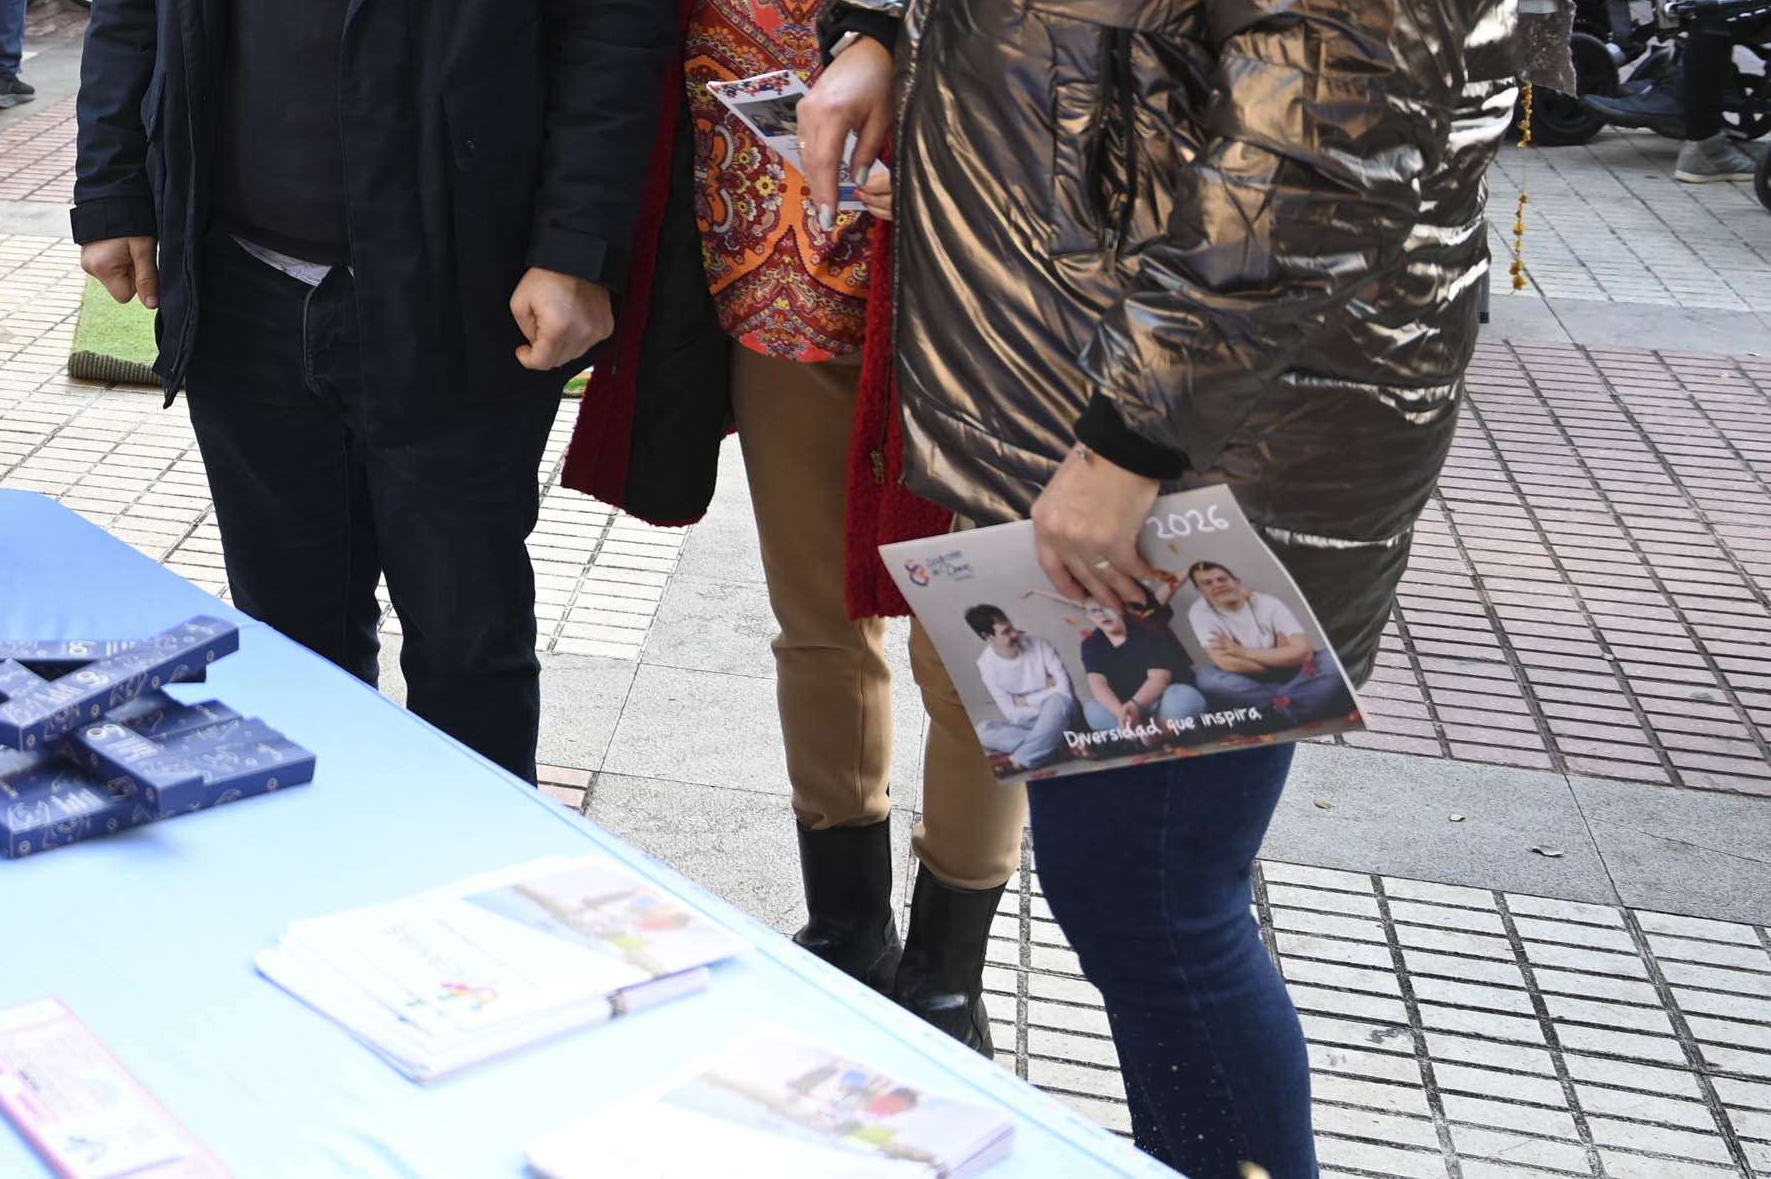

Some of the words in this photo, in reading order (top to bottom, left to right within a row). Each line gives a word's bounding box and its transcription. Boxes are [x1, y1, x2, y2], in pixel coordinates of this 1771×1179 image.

[1145, 504, 1229, 539] 2026
[1063, 717, 1162, 748] Diversidad
[1166, 716, 1196, 736] que
[1200, 706, 1262, 729] inspira
